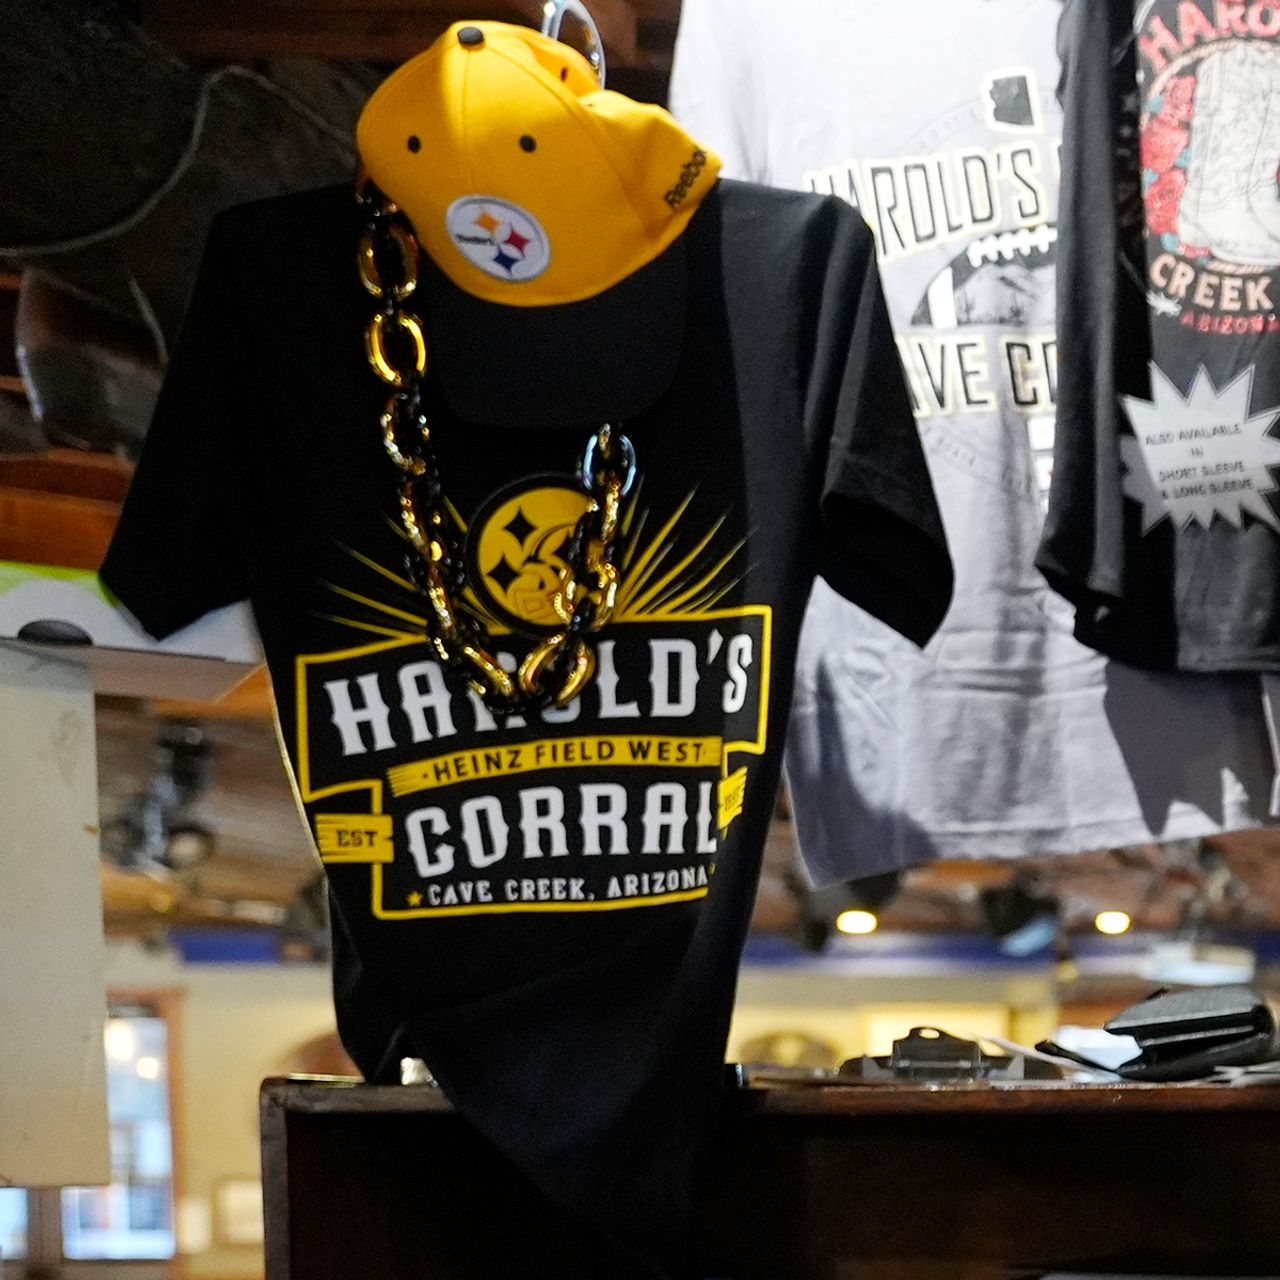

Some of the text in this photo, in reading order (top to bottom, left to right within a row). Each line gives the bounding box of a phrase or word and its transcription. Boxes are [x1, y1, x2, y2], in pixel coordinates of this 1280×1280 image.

[1148, 253, 1273, 312] CREEK
[1145, 422, 1243, 446] ALSO AVAILABLE
[1158, 460, 1246, 483] SHORT SLEEVE
[1208, 479, 1254, 495] SLEEVE
[432, 738, 702, 783] HEINZ FIELD WEST
[336, 829, 378, 849] EST
[405, 780, 718, 879] CORRAL
[428, 880, 493, 907] CAVE
[606, 866, 709, 899] ARIZONA
